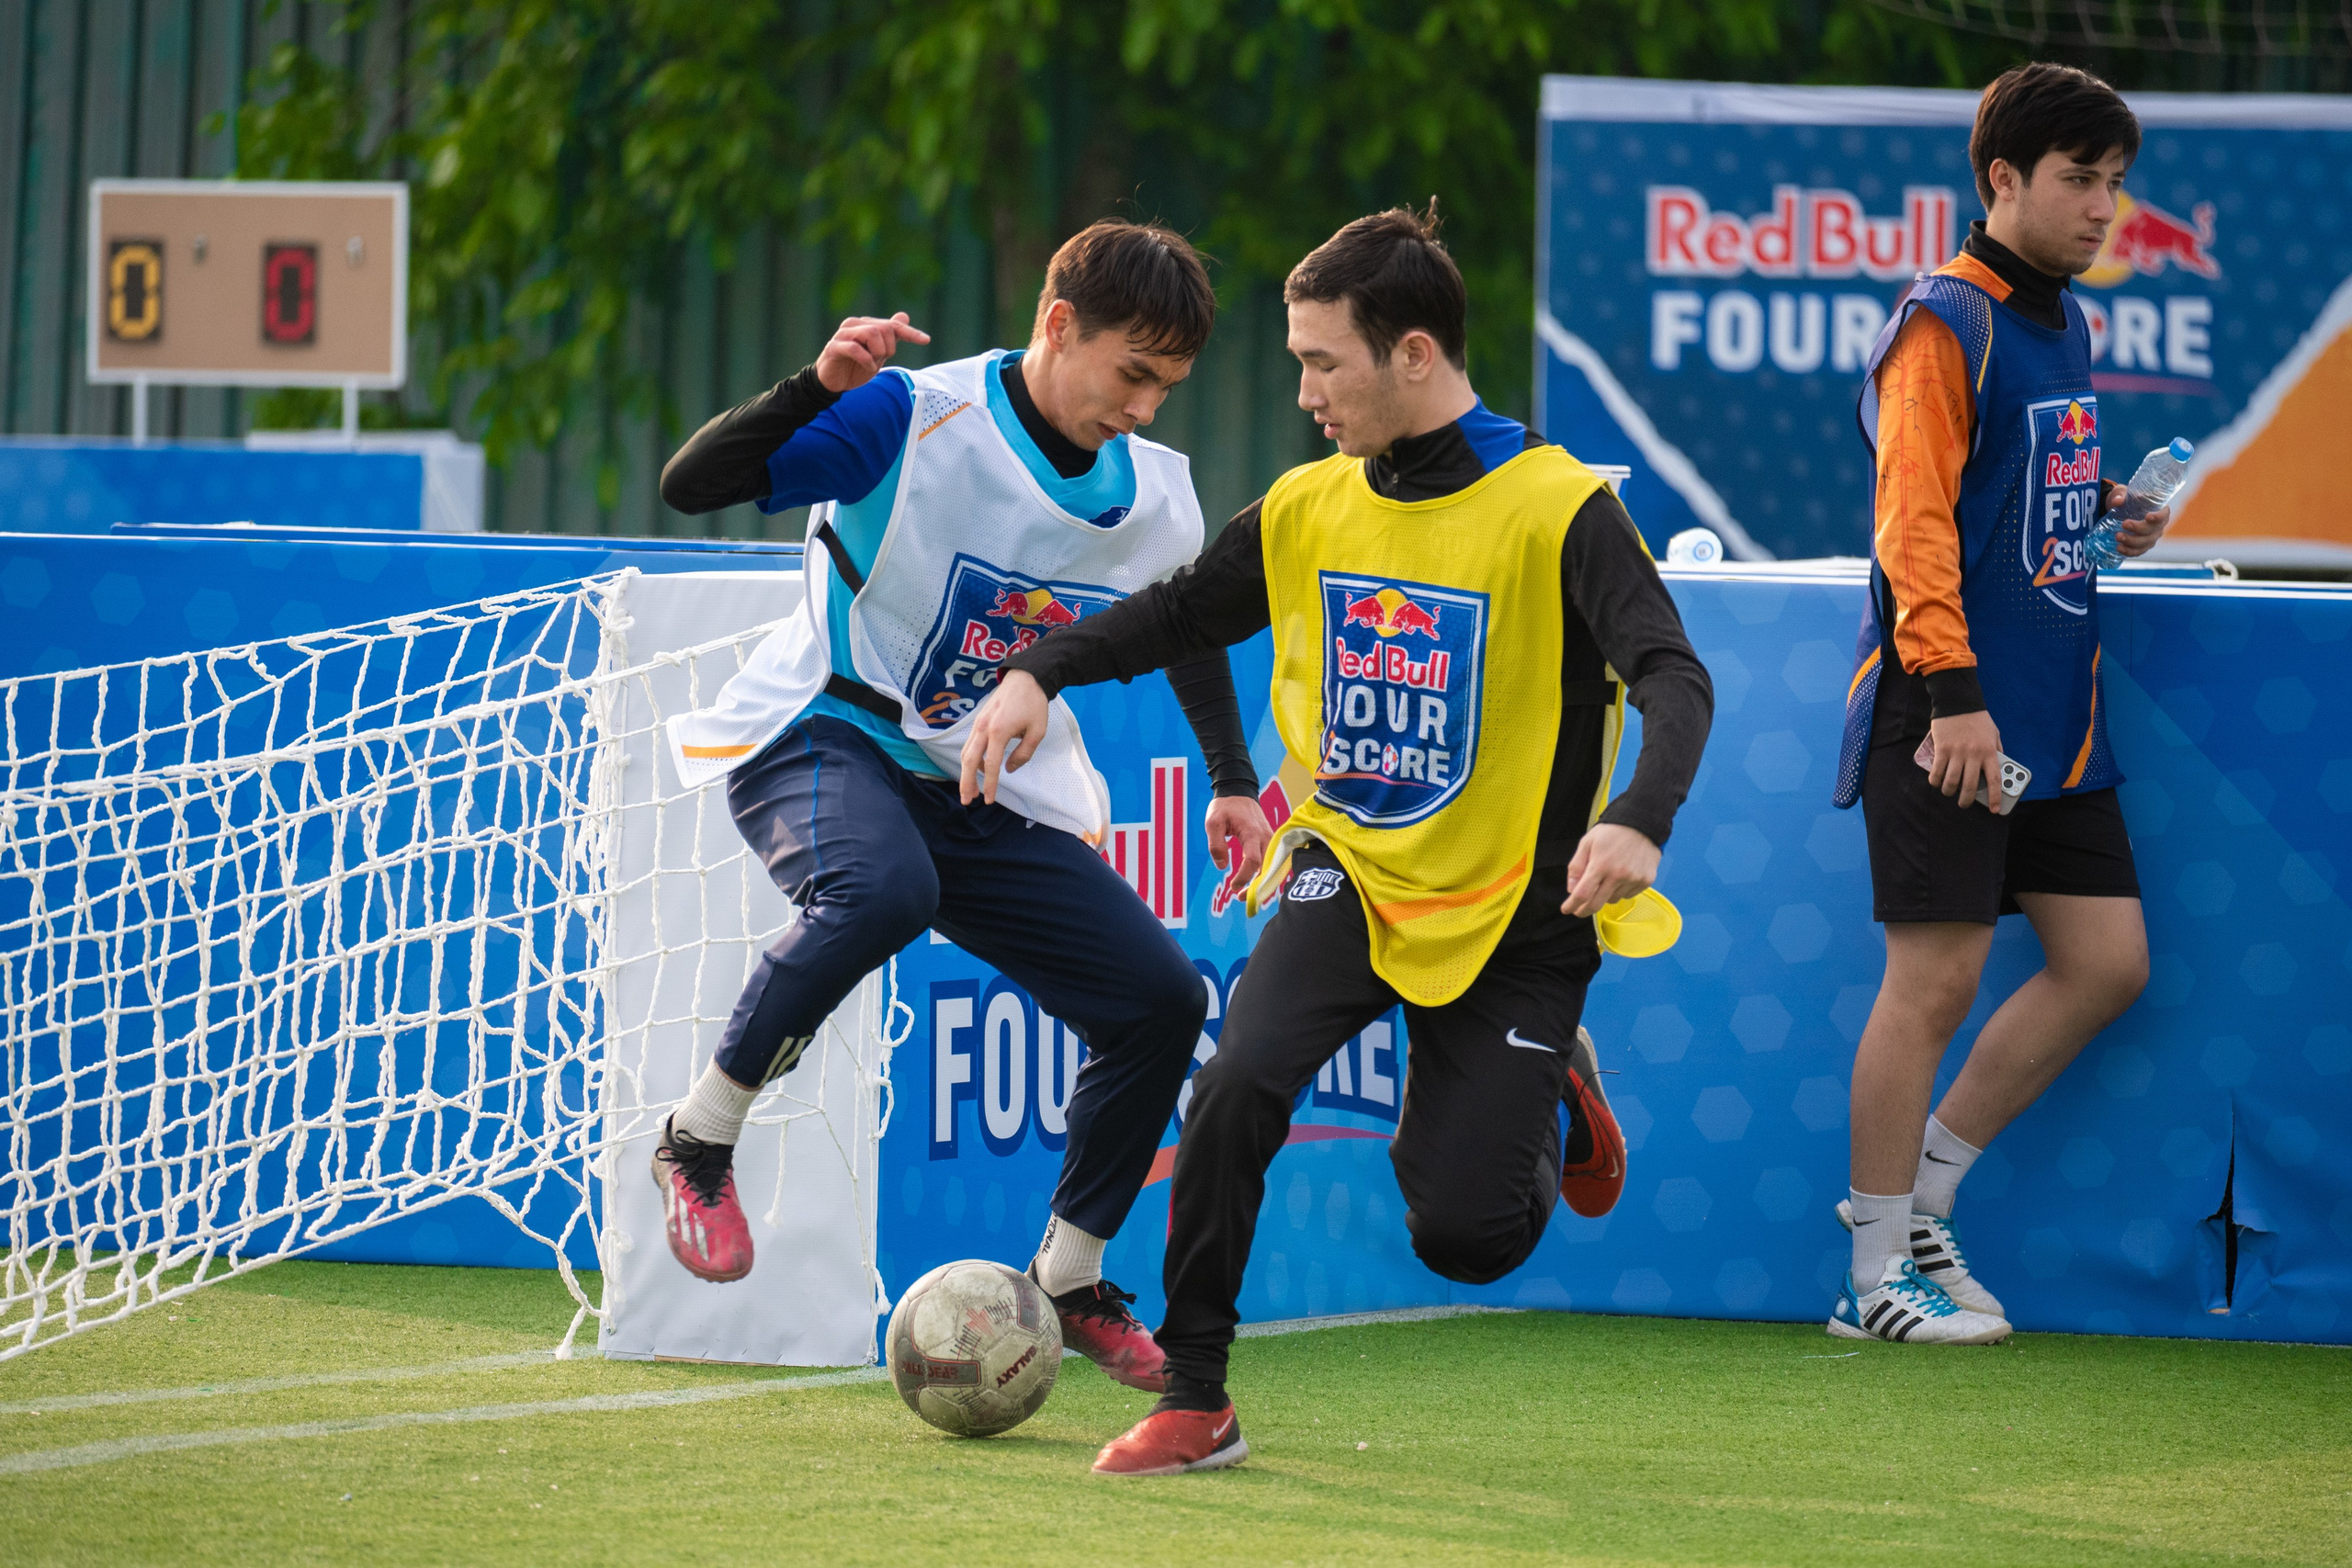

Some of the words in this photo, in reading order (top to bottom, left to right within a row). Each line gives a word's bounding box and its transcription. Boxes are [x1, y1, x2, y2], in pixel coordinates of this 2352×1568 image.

[1651, 188, 1799, 275] Red
[1808, 188, 1956, 276] Bull
[109, 245, 160, 339] 0
[264, 248, 315, 342] 0
[1651, 290, 1888, 373] FOUR
[1385, 644, 1451, 693] Bull
[1335, 682, 1448, 746] OUR
[1102, 758, 1187, 928] ull
[935, 991, 1082, 1143] FOU
[996, 1345, 1037, 1388] GALAXY
